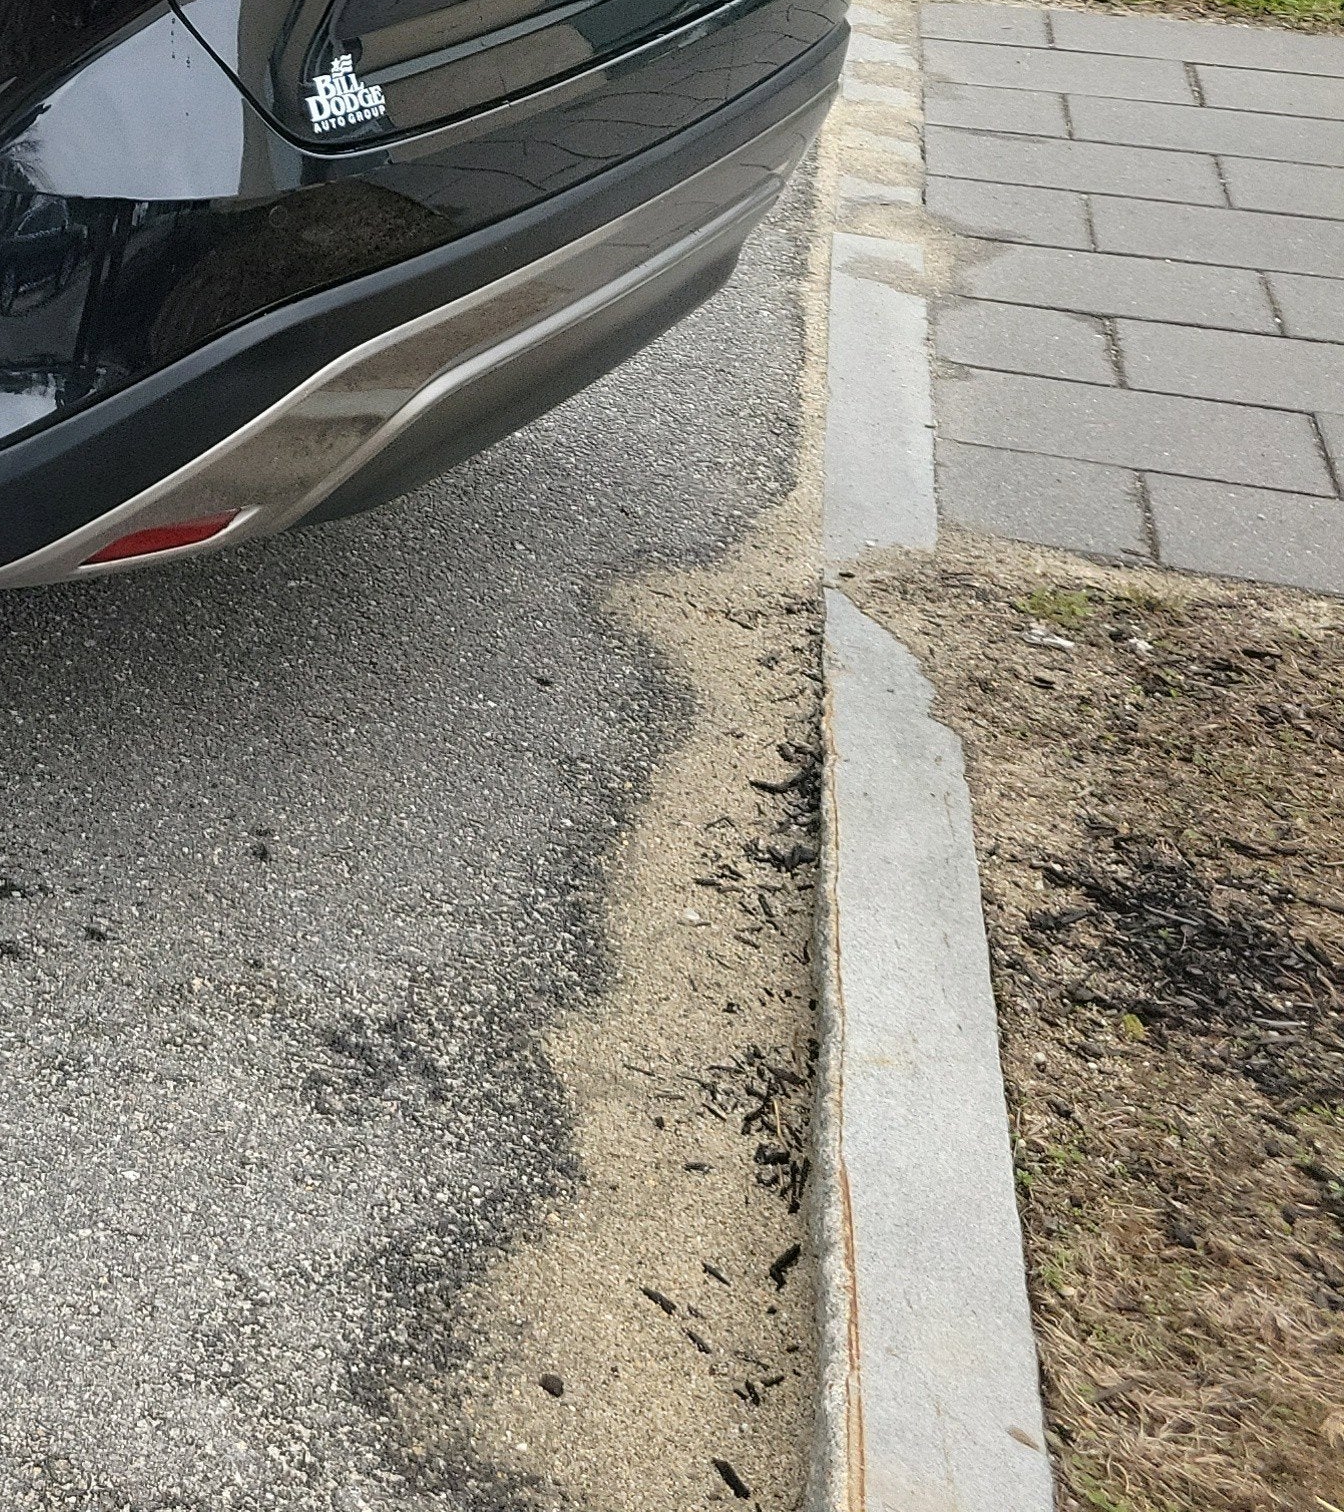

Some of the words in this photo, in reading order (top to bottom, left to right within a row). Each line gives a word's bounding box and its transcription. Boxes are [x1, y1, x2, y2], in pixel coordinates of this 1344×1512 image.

[312, 73, 365, 100] BILL
[304, 85, 386, 122] DODGE
[313, 115, 345, 134] AUTO
[347, 104, 387, 126] GROUP
